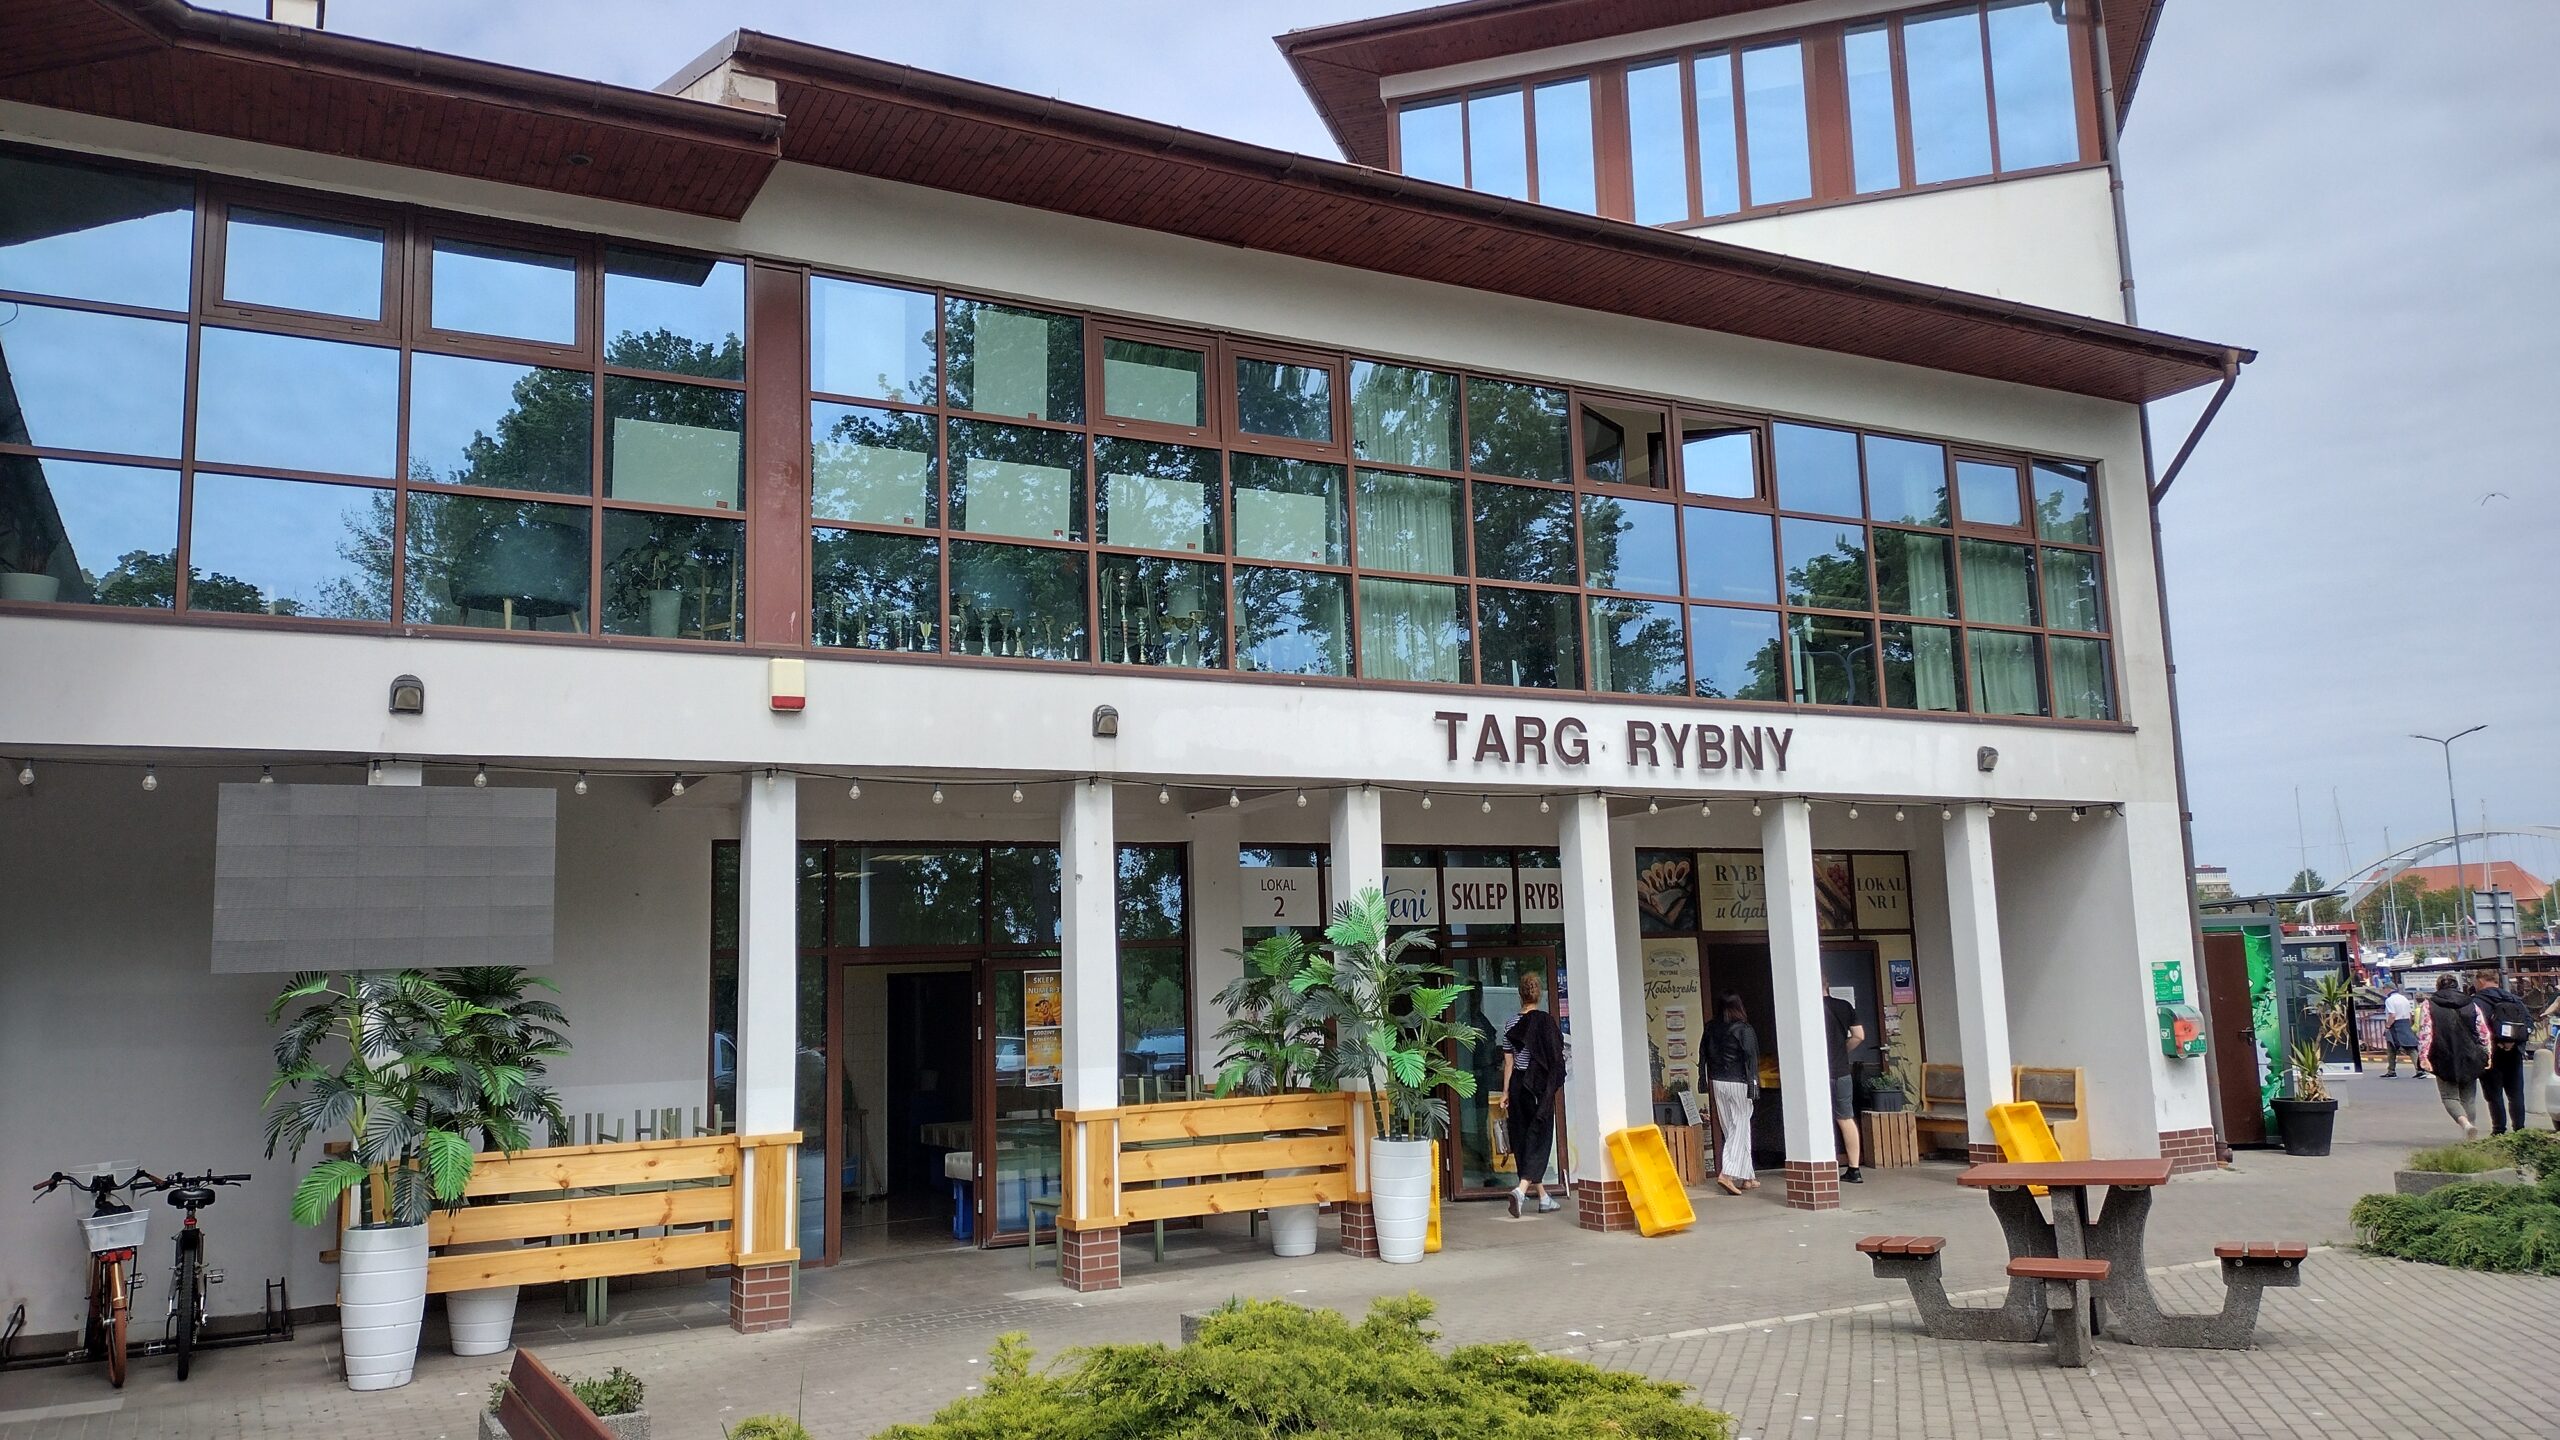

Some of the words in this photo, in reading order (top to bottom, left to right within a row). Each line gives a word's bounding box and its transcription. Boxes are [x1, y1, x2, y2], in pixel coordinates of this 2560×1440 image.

[1435, 711, 1590, 766] TARG
[1626, 720, 1793, 772] RYBNY
[1260, 879, 1297, 891] LOKAL
[1857, 877, 1906, 891] LOKAL
[1451, 883, 1508, 910] SKLEP
[1524, 883, 1564, 910] RYB
[1867, 895, 1888, 909] NR
[1273, 896, 1285, 917] 2
[1715, 907, 1726, 918] u
[1730, 901, 1768, 924] Agat
[1890, 964, 1910, 975] Rejsy
[1033, 976, 1054, 984] SKLEP
